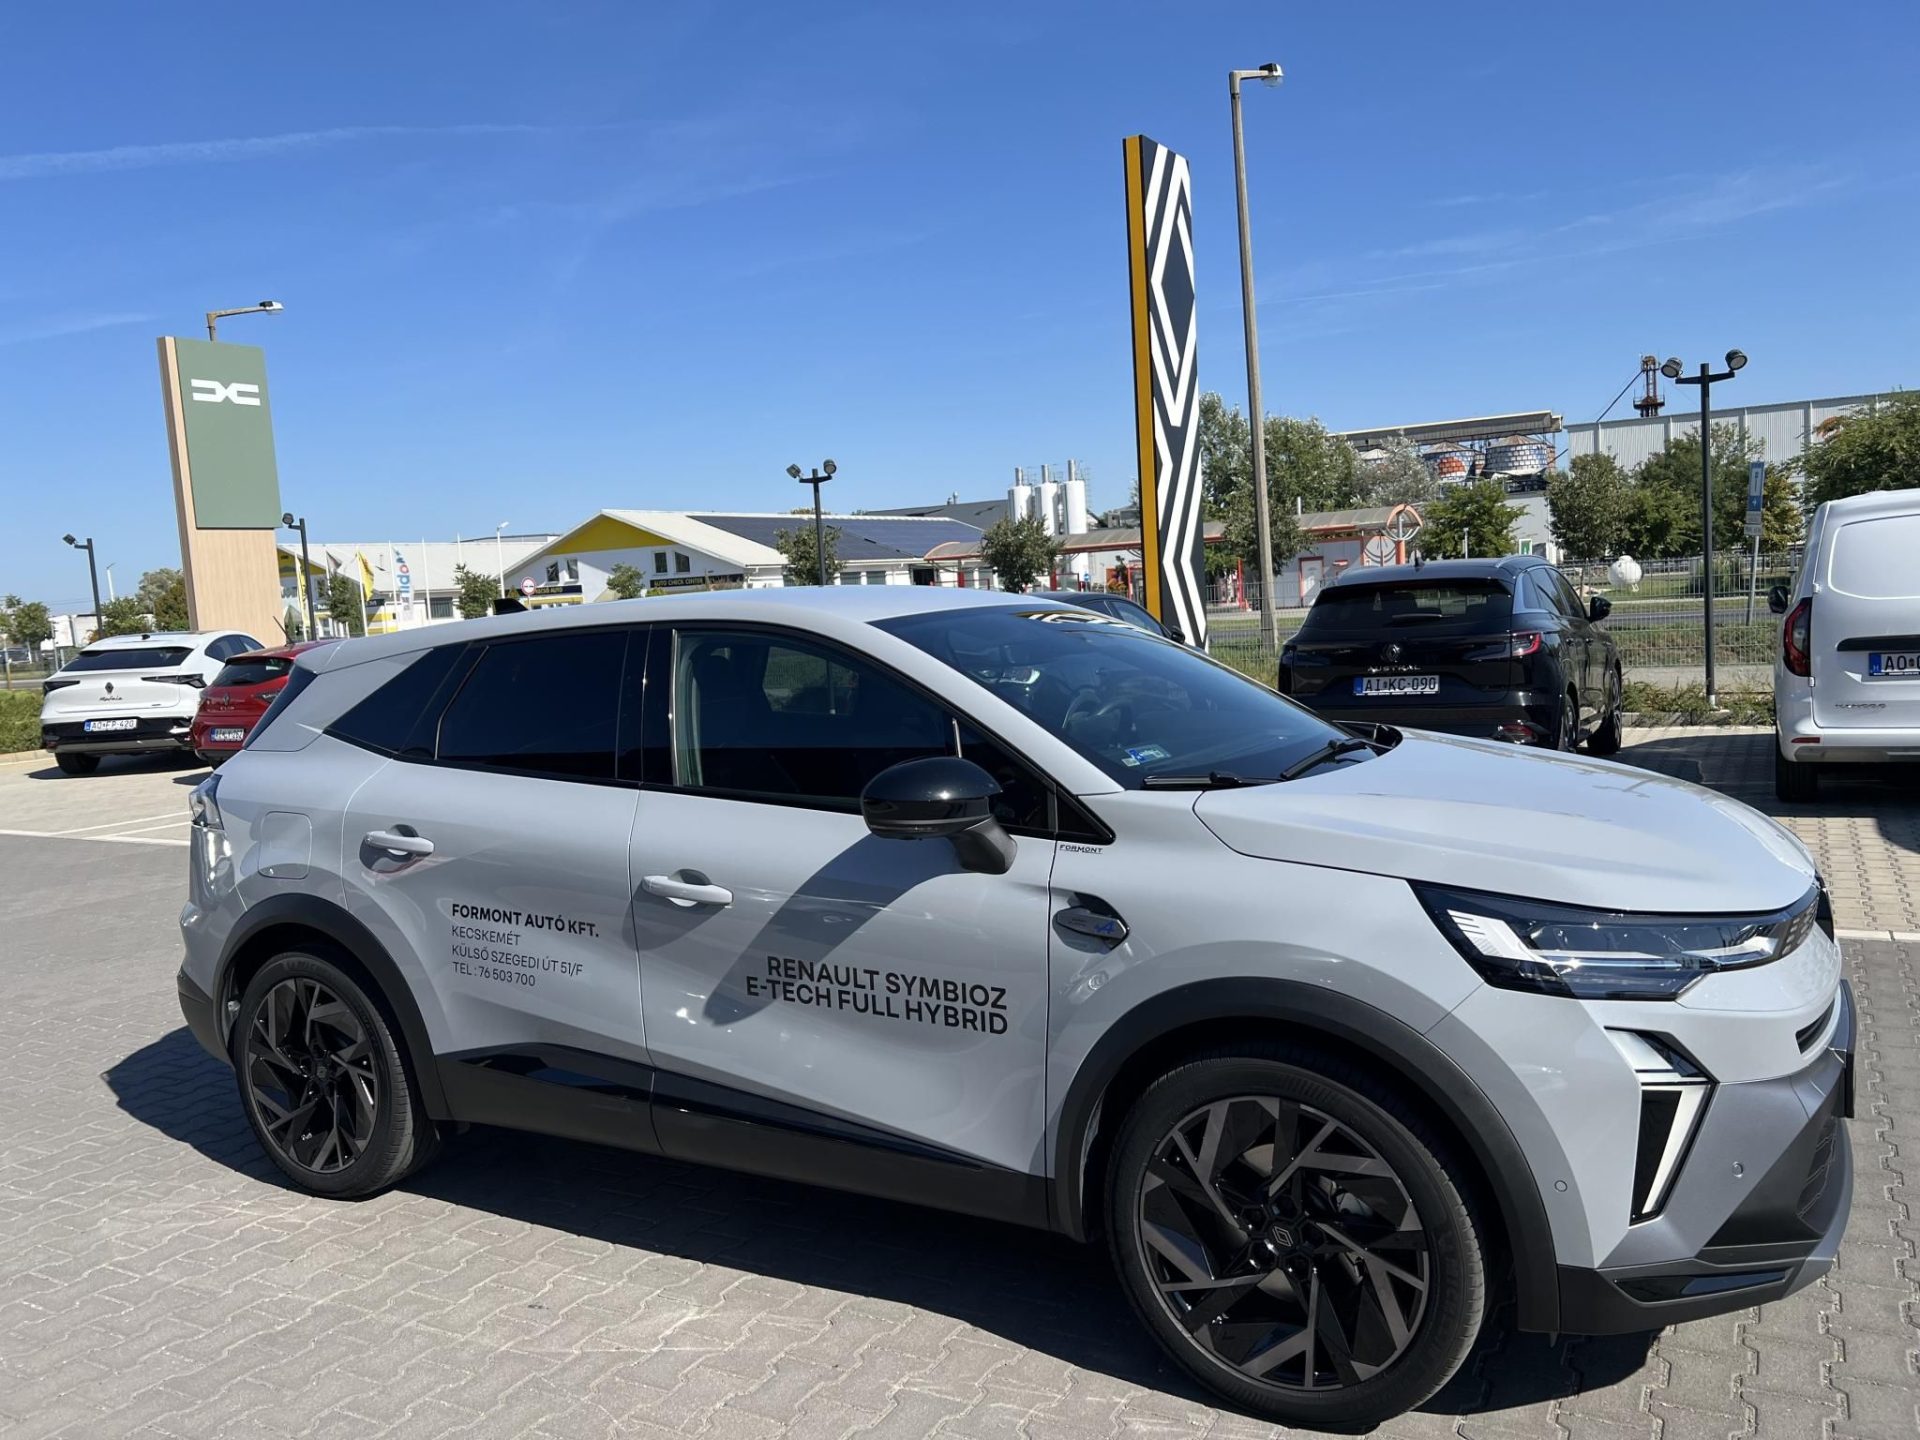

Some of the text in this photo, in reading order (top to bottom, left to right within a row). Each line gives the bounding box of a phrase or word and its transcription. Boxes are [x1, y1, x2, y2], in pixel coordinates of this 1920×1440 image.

[1060, 844, 1104, 854] FORMONT
[452, 903, 600, 938] FORMONT AUTÓ KFT.
[452, 925, 521, 946] KECSKEMÉT
[452, 942, 584, 977] KÜLSŐ SZEGEDI ÚT 51/F
[478, 966, 491, 979] 76
[493, 968, 513, 983] 503
[515, 972, 536, 987] 700
[767, 956, 1008, 1011] RENAULT SYMBIOZ
[746, 976, 1009, 1036] E-TECH FULL HYBRID
